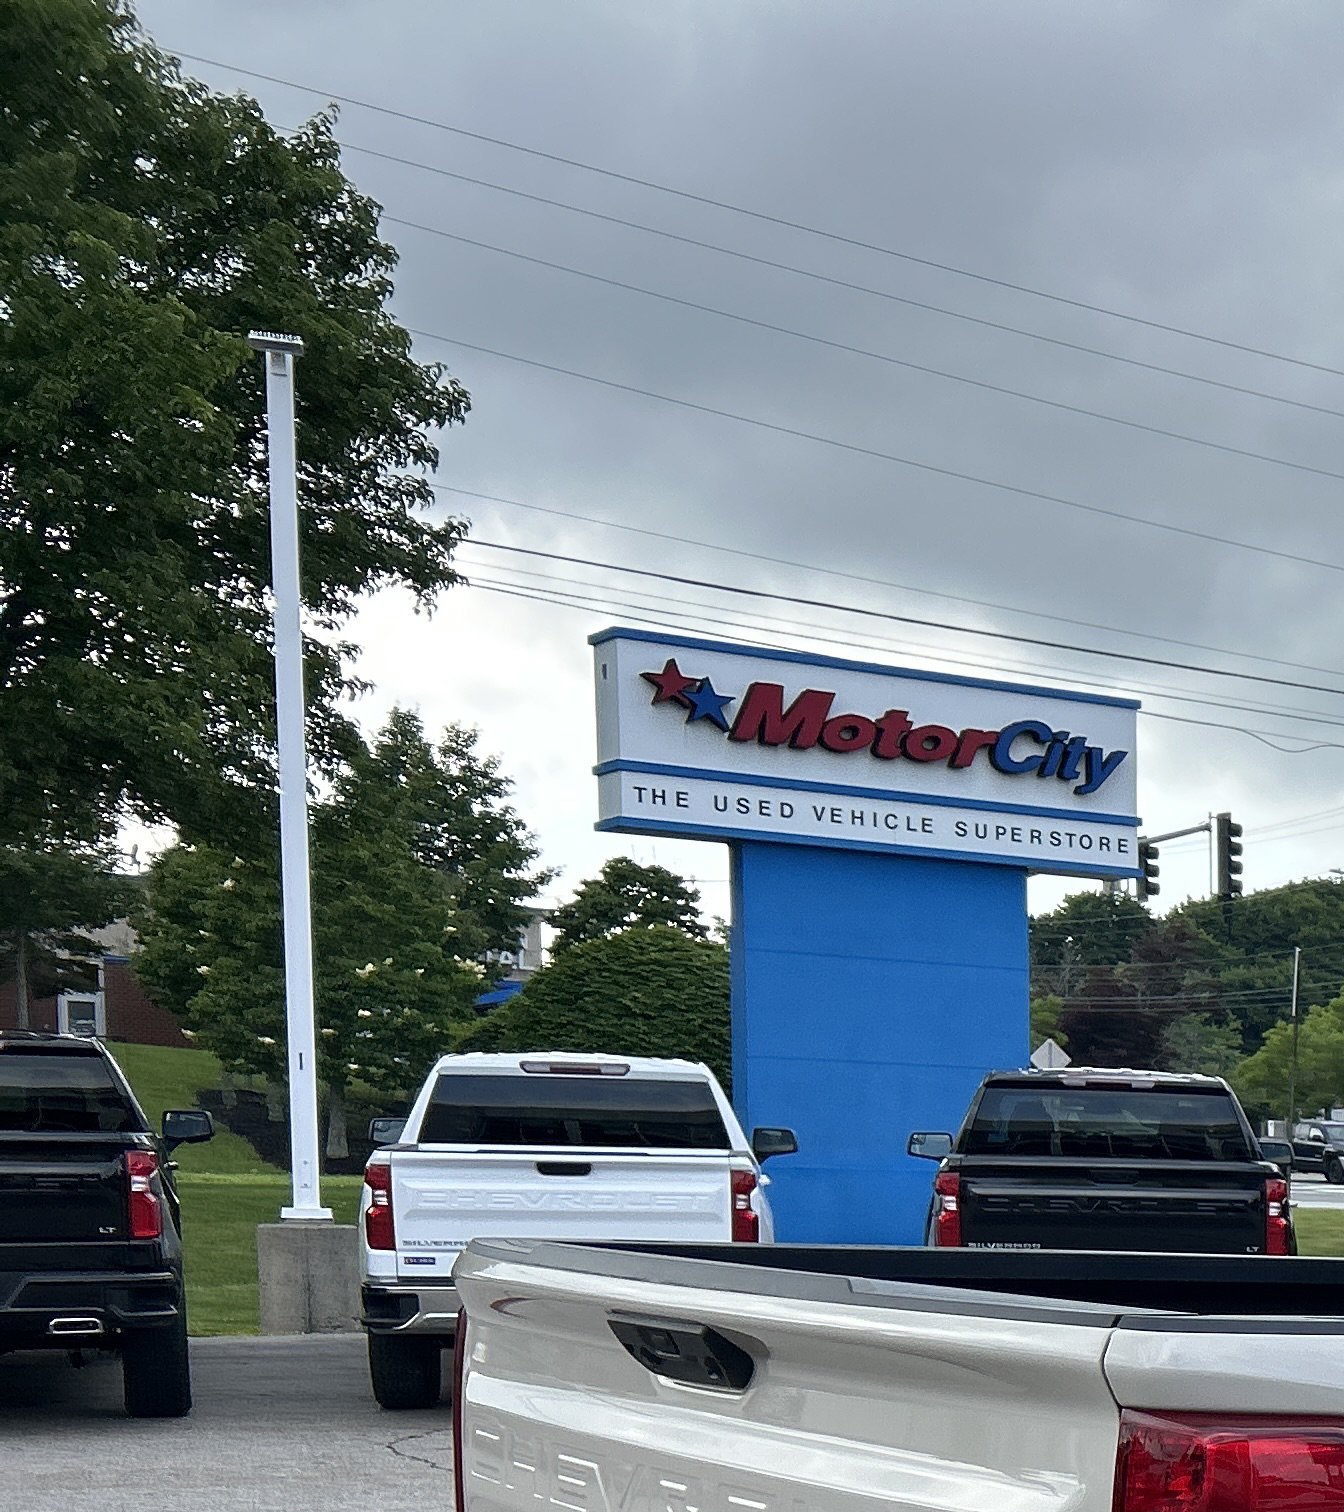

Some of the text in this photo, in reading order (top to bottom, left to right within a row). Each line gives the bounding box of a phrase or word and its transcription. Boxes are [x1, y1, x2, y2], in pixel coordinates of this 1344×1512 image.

[727, 682, 1128, 795] MotorCity
[633, 786, 1130, 854] THE USED VEHICLE SUPERSTORE
[416, 1190, 711, 1211] CHEVROLET
